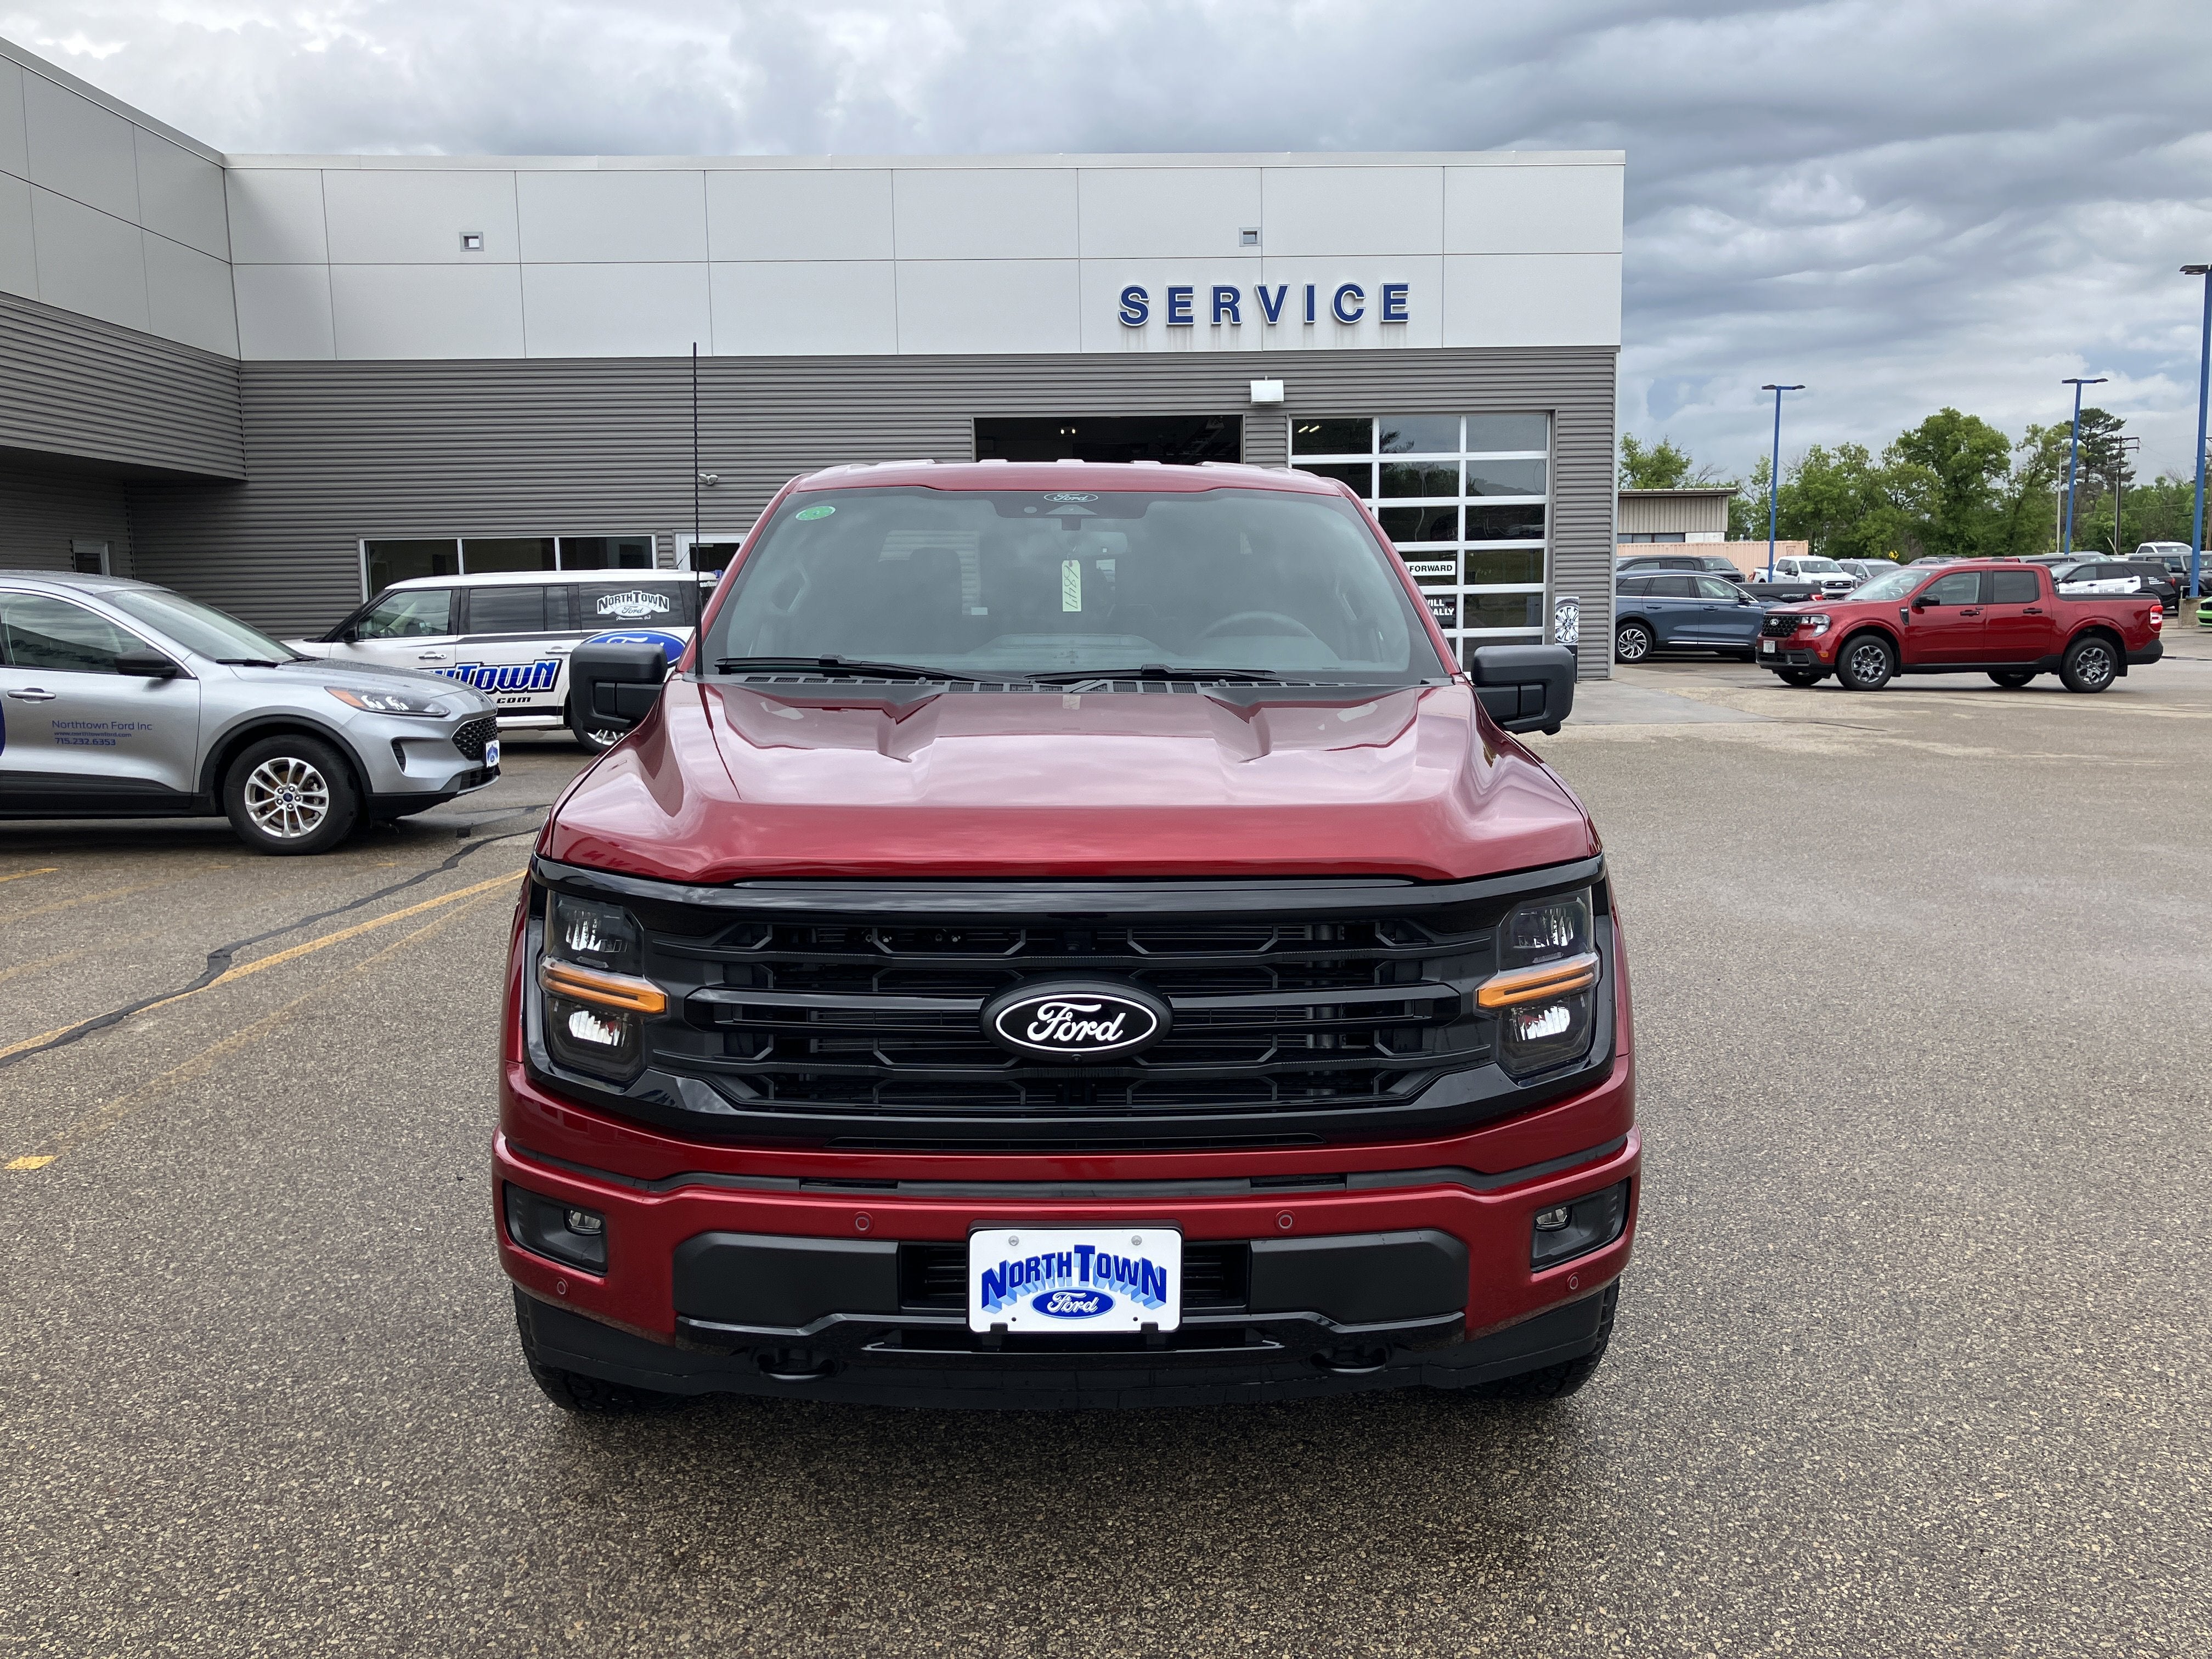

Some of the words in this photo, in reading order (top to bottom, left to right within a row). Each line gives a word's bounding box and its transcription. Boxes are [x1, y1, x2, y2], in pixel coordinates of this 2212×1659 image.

[1119, 282, 1410, 326] SERVICE
[622, 606, 644, 614] Ford
[52, 720, 109, 730] Northtown
[111, 721, 134, 730] Ford
[138, 722, 153, 731] Inc
[1027, 1002, 1126, 1041] Ford
[1047, 1291, 1099, 1313] Ford
